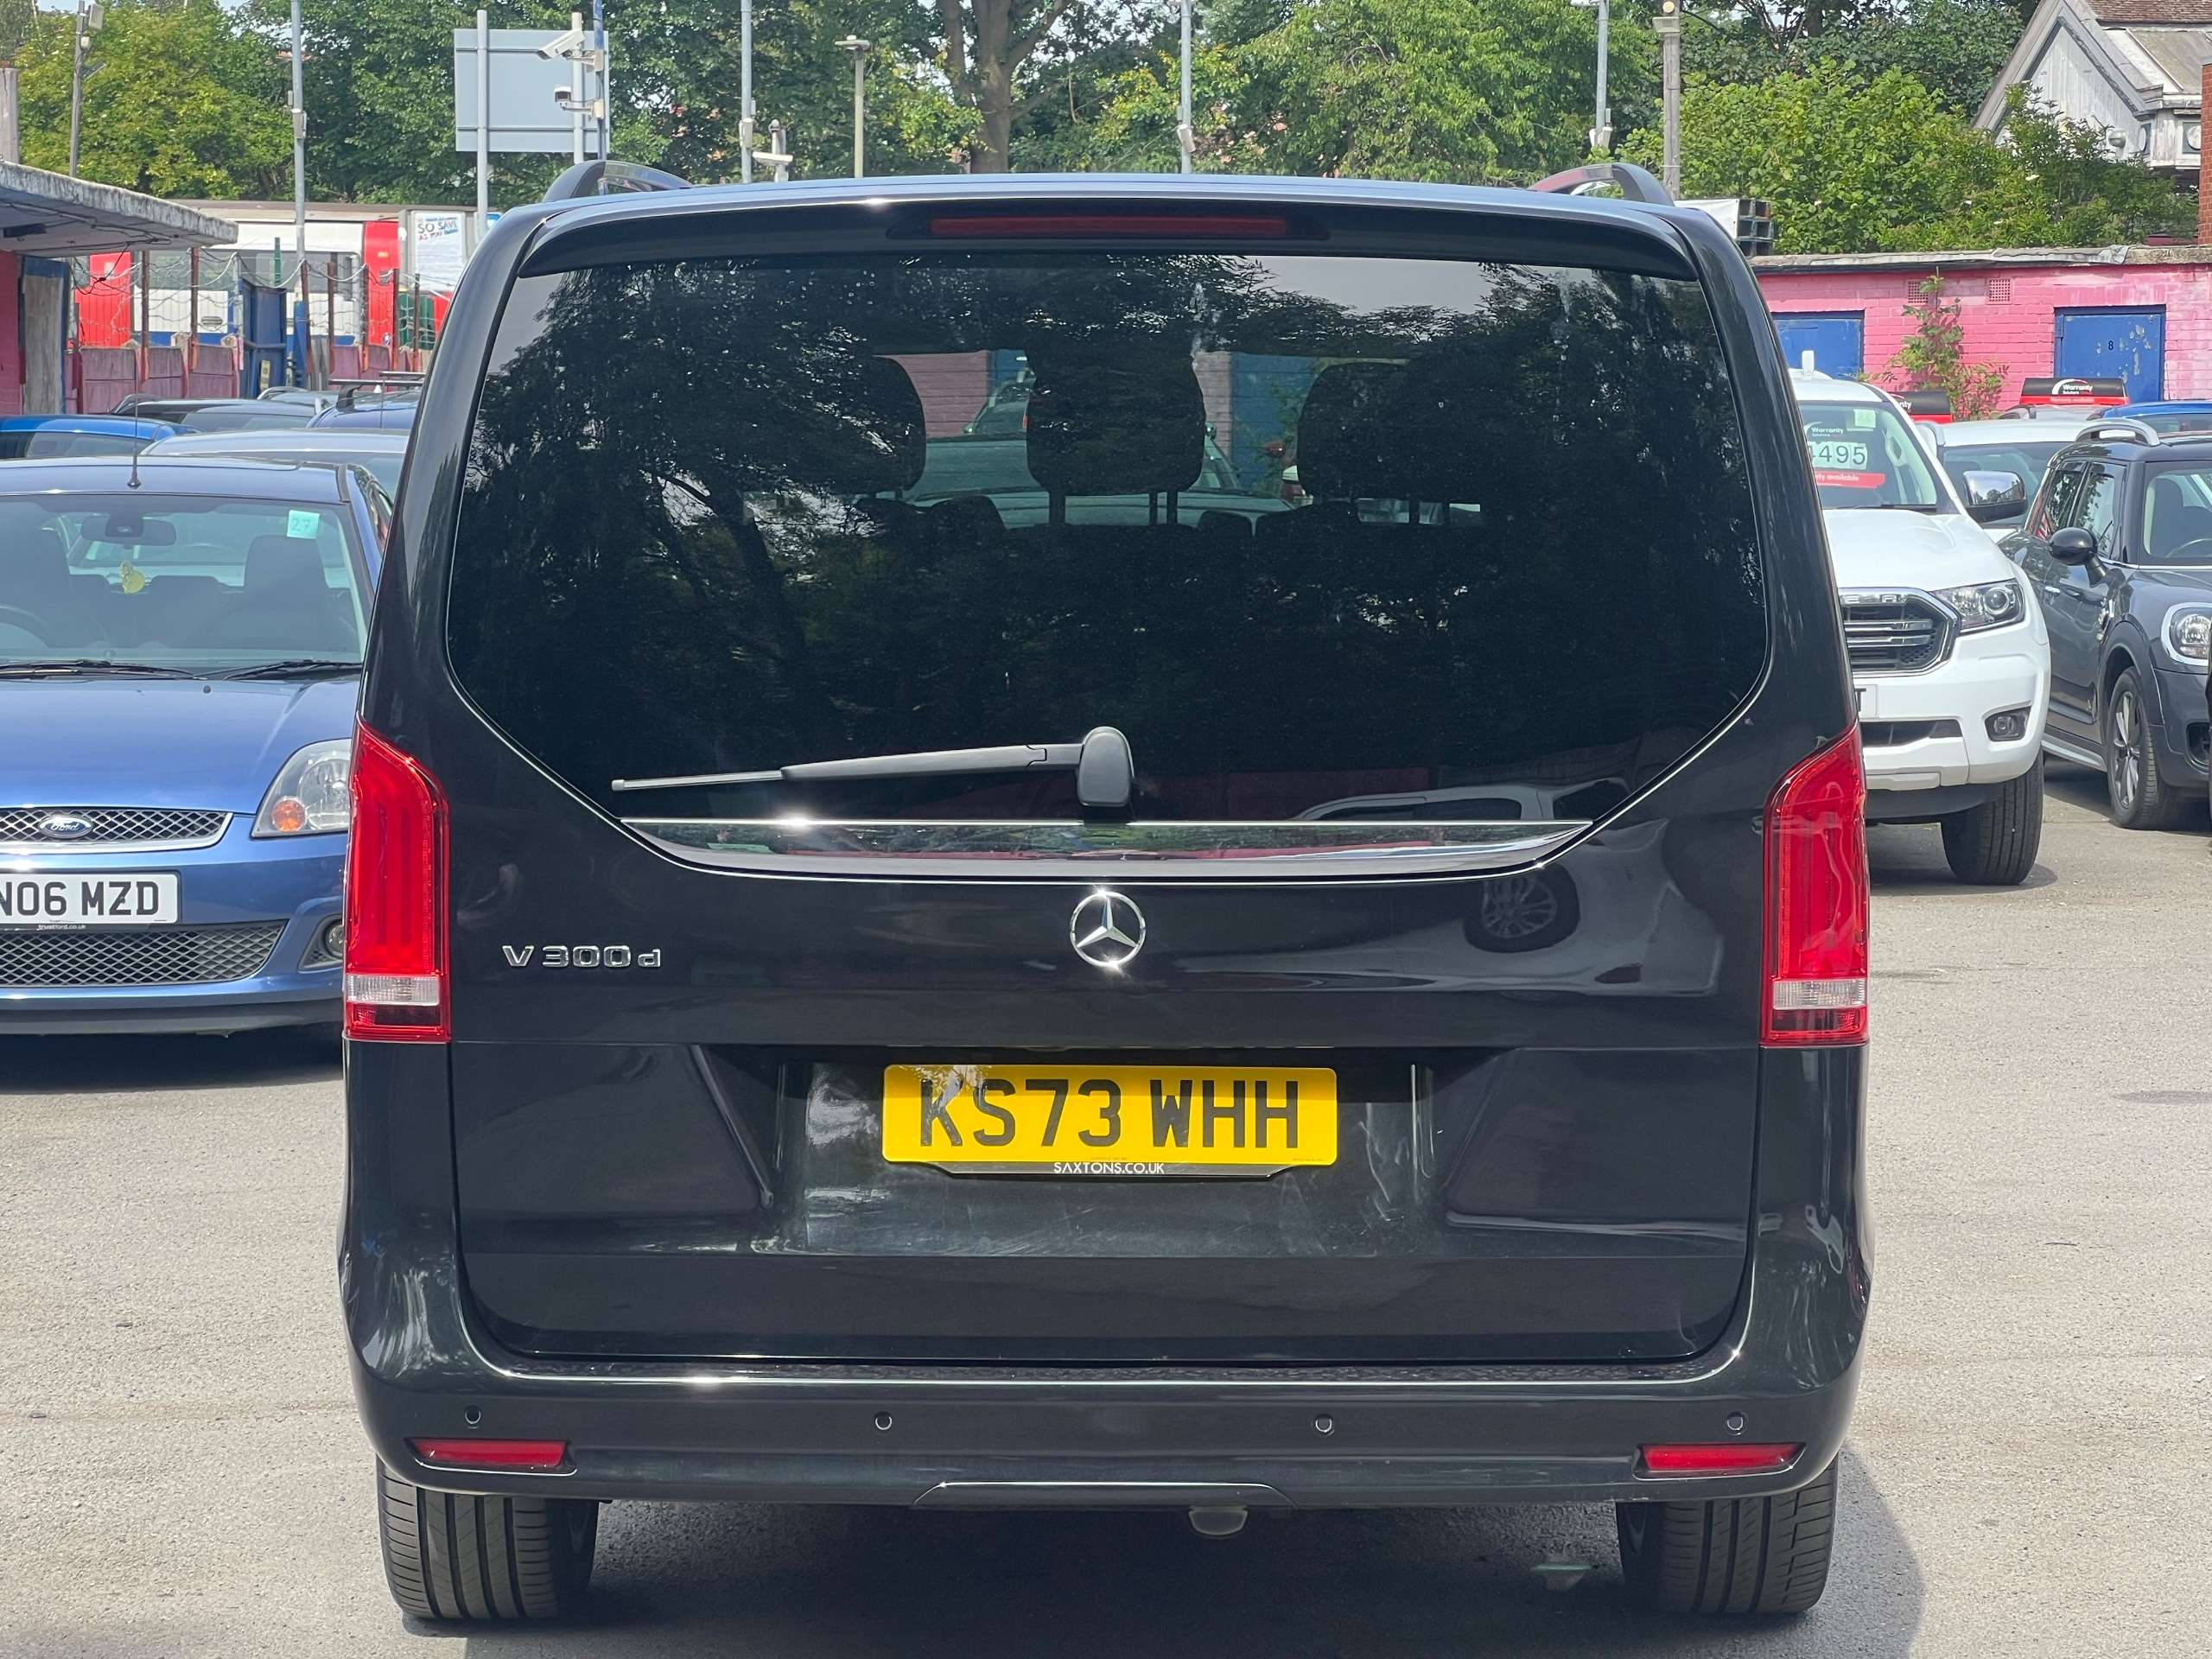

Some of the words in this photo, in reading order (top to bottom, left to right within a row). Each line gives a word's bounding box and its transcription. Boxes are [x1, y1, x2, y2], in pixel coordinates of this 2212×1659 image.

[417, 222, 435, 234] SO
[2107, 340, 2114, 351] 8
[2063, 384, 2093, 392] Warranty
[81, 881, 159, 916] MZD
[920, 1078, 1122, 1147] KS73
[1149, 1079, 1299, 1148] WHH
[1053, 1161, 1165, 1174] SAXTONS.CO.UK
